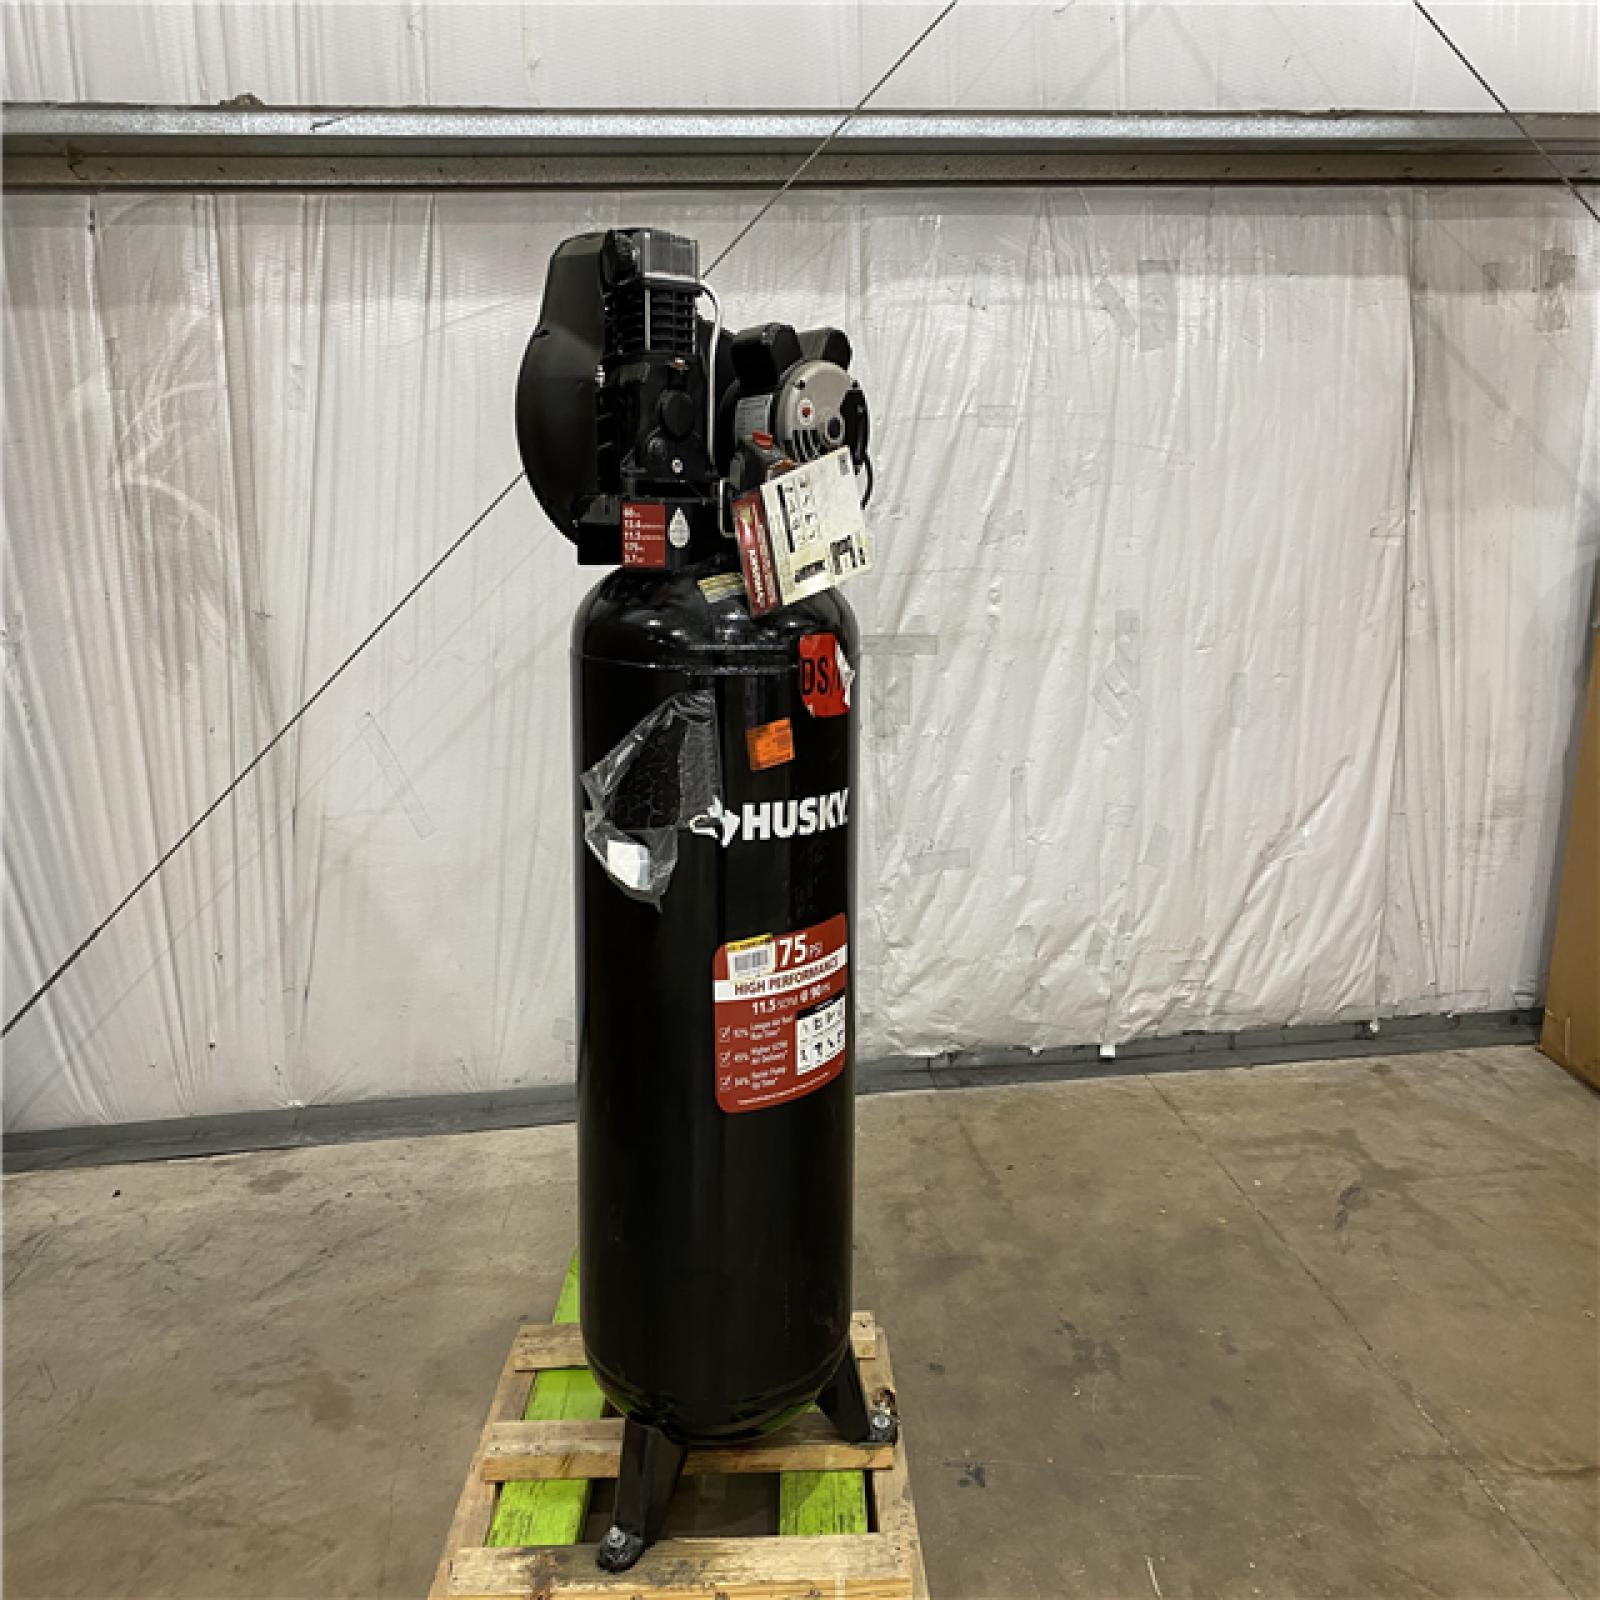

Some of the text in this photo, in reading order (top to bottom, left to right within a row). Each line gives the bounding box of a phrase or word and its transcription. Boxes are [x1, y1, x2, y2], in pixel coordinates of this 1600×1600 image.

[741, 787, 849, 841] HUSKY
[734, 954, 838, 996] HIGH PERFORMANCE
